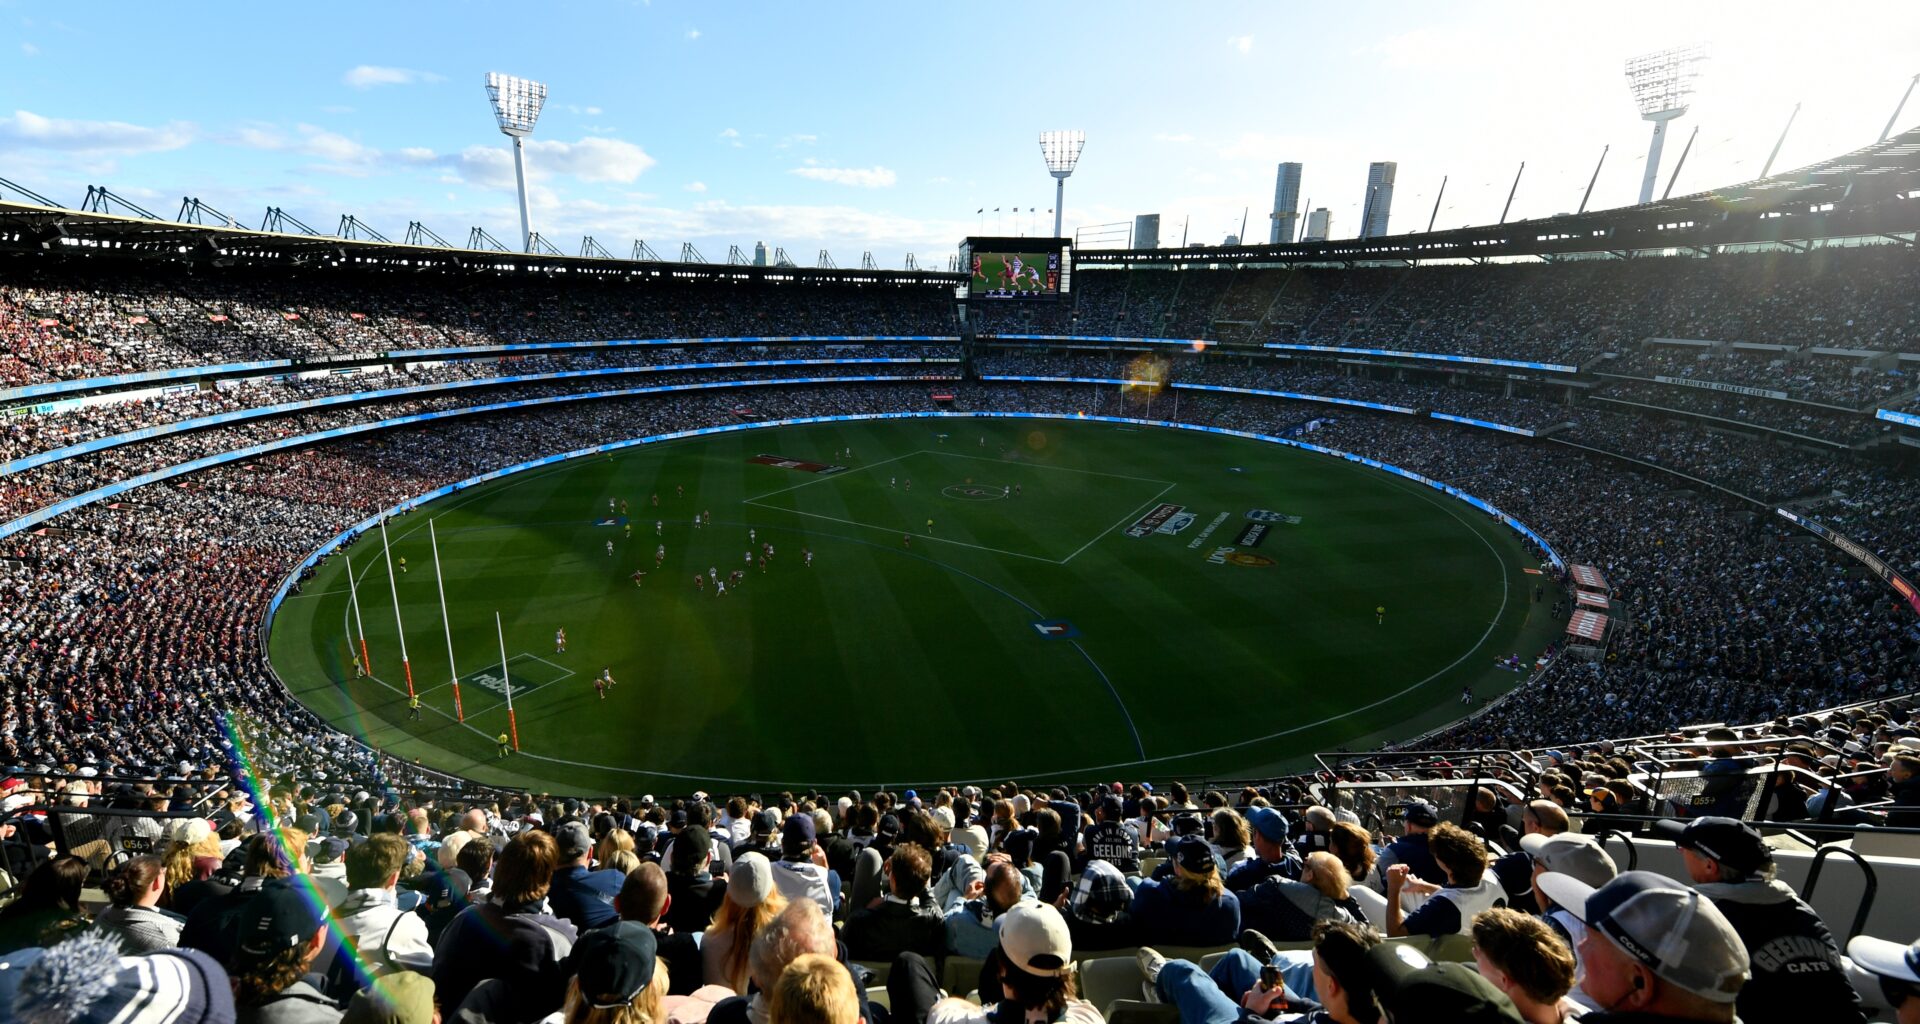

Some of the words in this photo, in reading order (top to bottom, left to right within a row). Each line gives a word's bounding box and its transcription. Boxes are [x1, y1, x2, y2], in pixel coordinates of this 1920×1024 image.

[305, 356, 329, 365] SHANE
[330, 354, 355, 362] WARNE
[355, 352, 378, 361] STAND
[1671, 377, 1712, 389] MELBOURNE
[1715, 383, 1745, 394] CRICKET
[1748, 388, 1766, 397] CLUB
[1092, 830, 1104, 843] ONE
[123, 839, 143, 849] Q56
[1093, 844, 1133, 859] GEELONG
[1786, 961, 1831, 974] CATS
